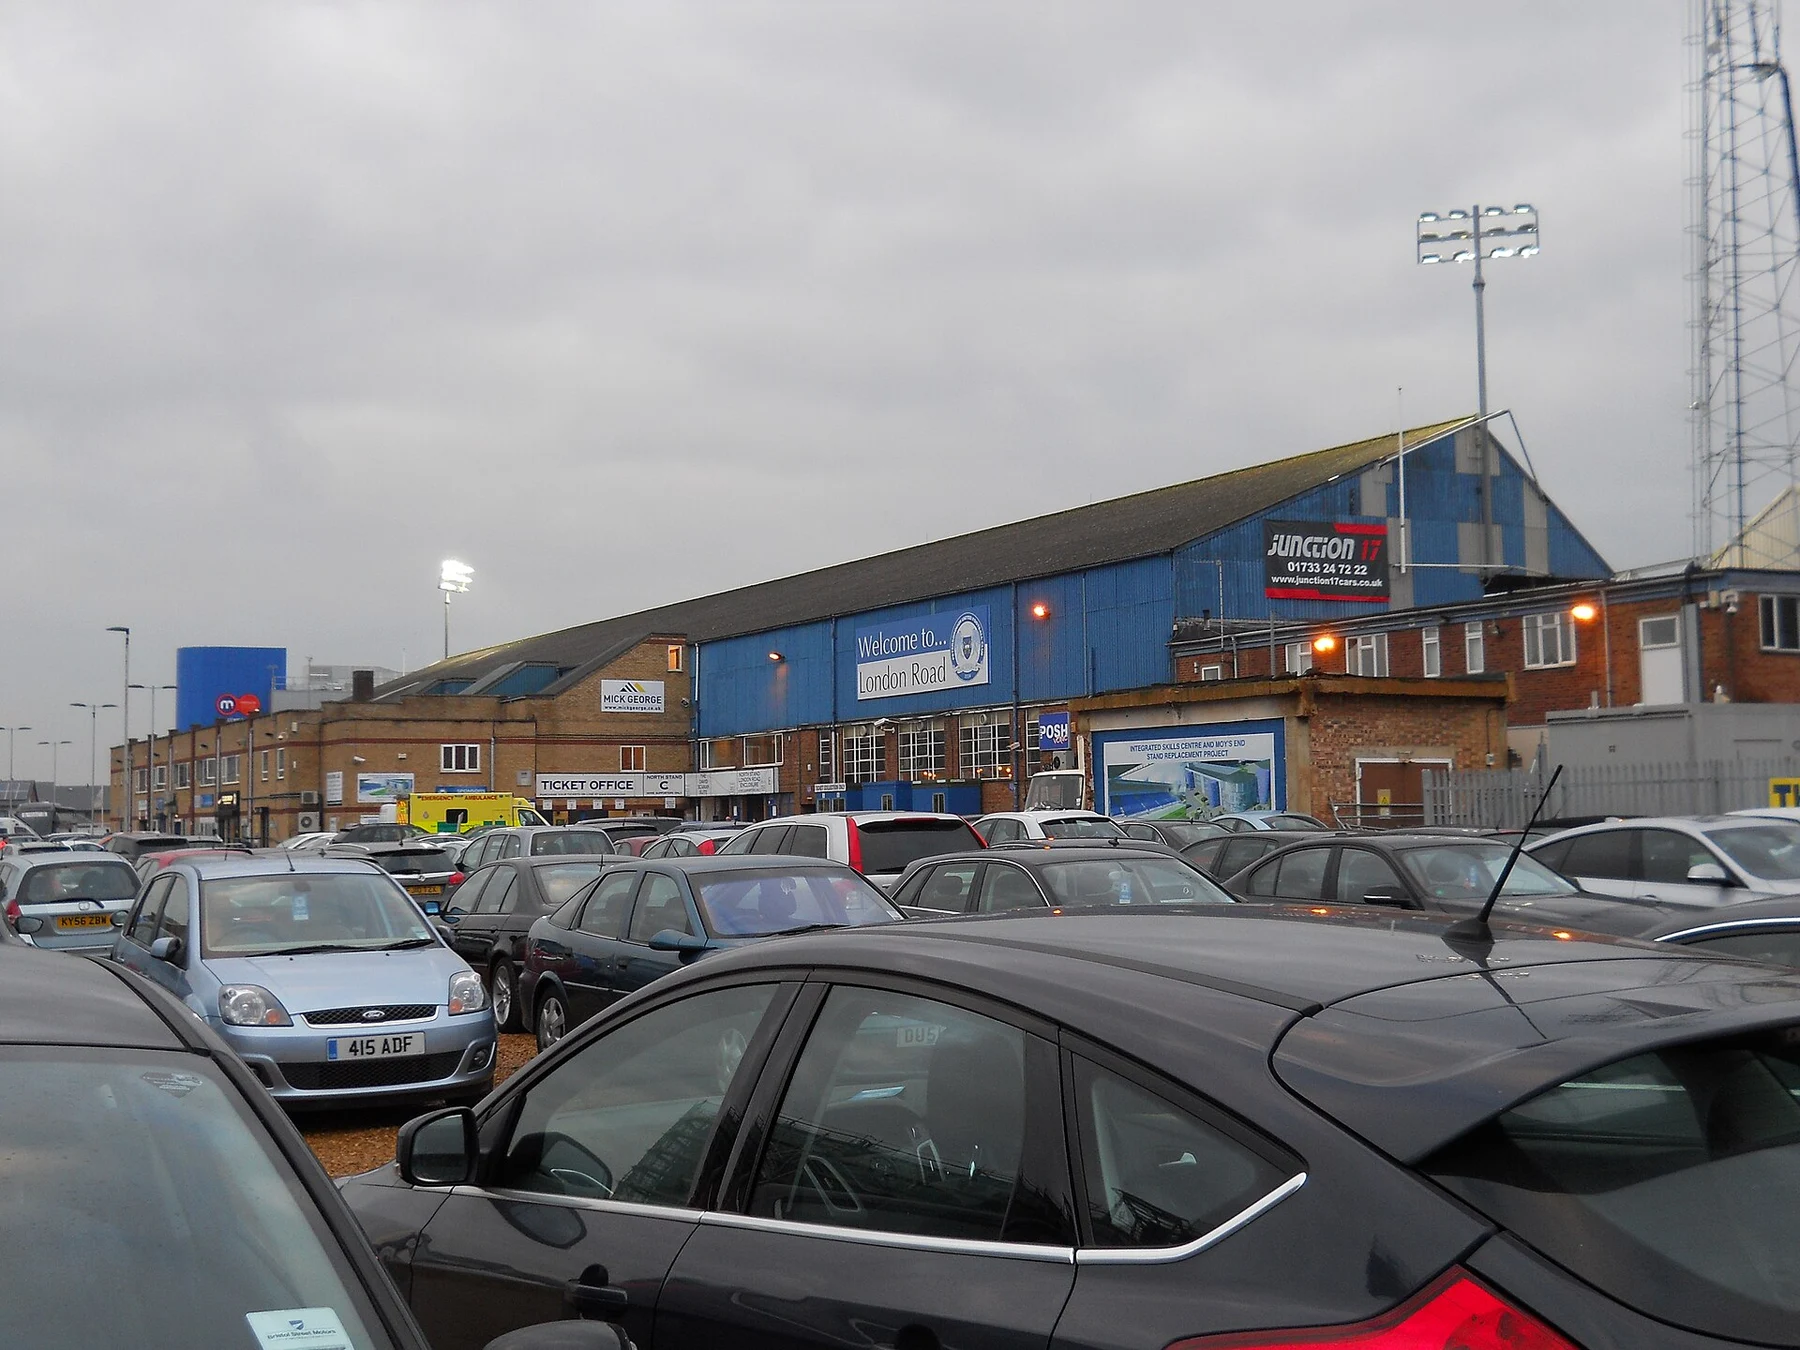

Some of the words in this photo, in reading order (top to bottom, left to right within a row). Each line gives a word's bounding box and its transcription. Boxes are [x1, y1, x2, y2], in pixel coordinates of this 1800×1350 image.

[1361, 539, 1382, 562] 17
[1287, 561, 1320, 573] 01733
[1323, 563, 1336, 574] 24
[1338, 564, 1351, 575] 72
[1353, 565, 1368, 575] 22
[1271, 575, 1383, 587] www.junction17cars.co.uk
[858, 631, 918, 658] Welcome
[921, 628, 947, 648] to...
[859, 665, 907, 694] London
[912, 656, 946, 686] Road
[603, 695, 626, 703] MICK
[627, 695, 662, 704] GEORGE
[1040, 723, 1068, 739] POSH
[1130, 744, 1162, 752] INTEGRATED
[1162, 743, 1180, 751] SKILLS
[1181, 742, 1202, 750] CENTRE
[1202, 741, 1215, 749] AND
[1215, 740, 1233, 748] MOY'S
[1233, 739, 1246, 747] END
[1164, 751, 1203, 759] REPLACEMENT
[1203, 750, 1229, 758] PROJECT
[541, 780, 586, 790] TICKET
[590, 780, 634, 790] OFFICE
[659, 781, 669, 790] C
[61, 916, 86, 926] KY56
[349, 1039, 375, 1056] 415
[381, 1036, 413, 1054] ADF
